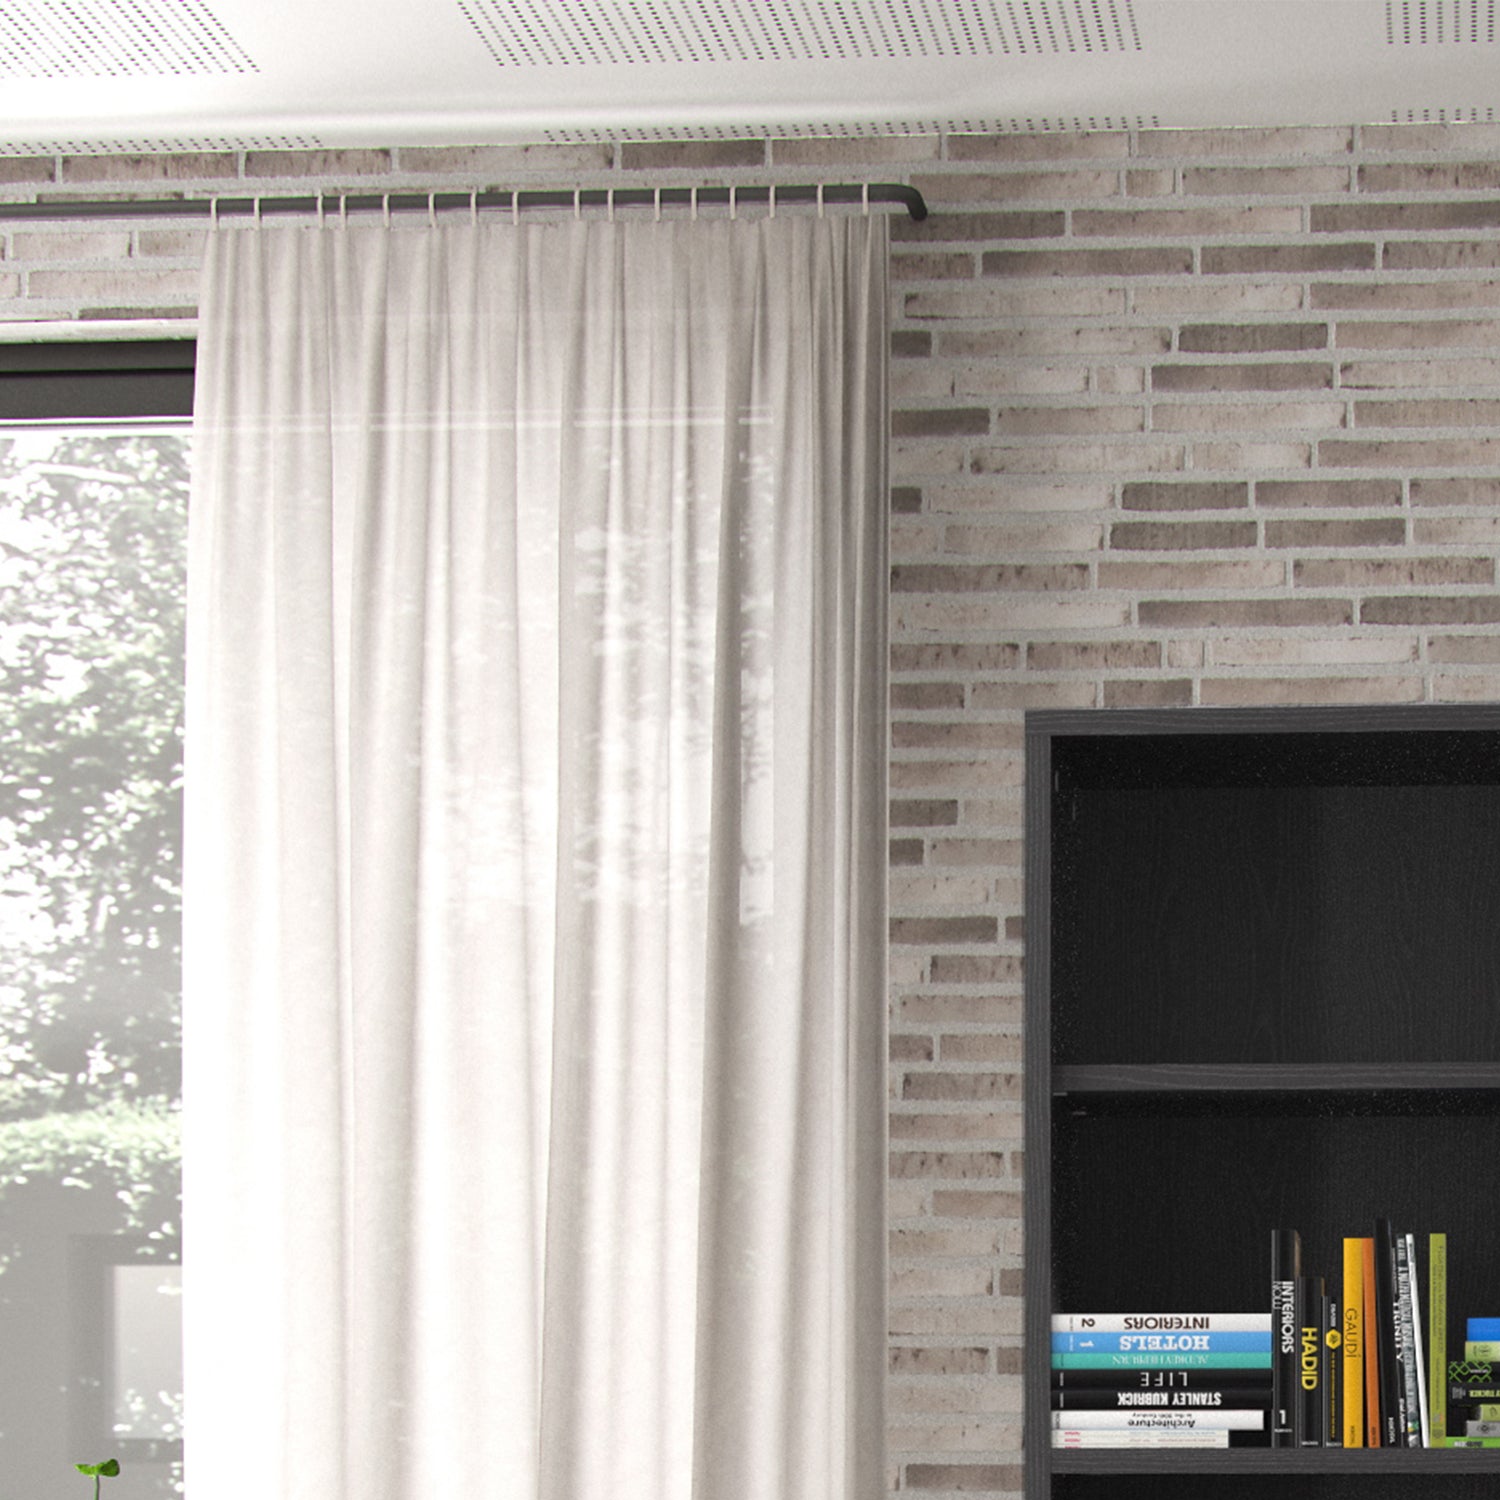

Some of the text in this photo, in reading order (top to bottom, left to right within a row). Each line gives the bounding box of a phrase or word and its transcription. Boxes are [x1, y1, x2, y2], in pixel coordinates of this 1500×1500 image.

[1123, 1317, 1210, 1329] INTERIORS
[1281, 1281, 1294, 1354] INTERIORS
[1344, 1307, 1362, 1359] GAUDÍ
[1119, 1335, 1210, 1351] HOTELS
[1301, 1327, 1318, 1390] HADID
[1140, 1372, 1188, 1386] LIFE
[1118, 1392, 1222, 1406] STANLEY KUBRICK
[1127, 1419, 1196, 1428] Architecture
